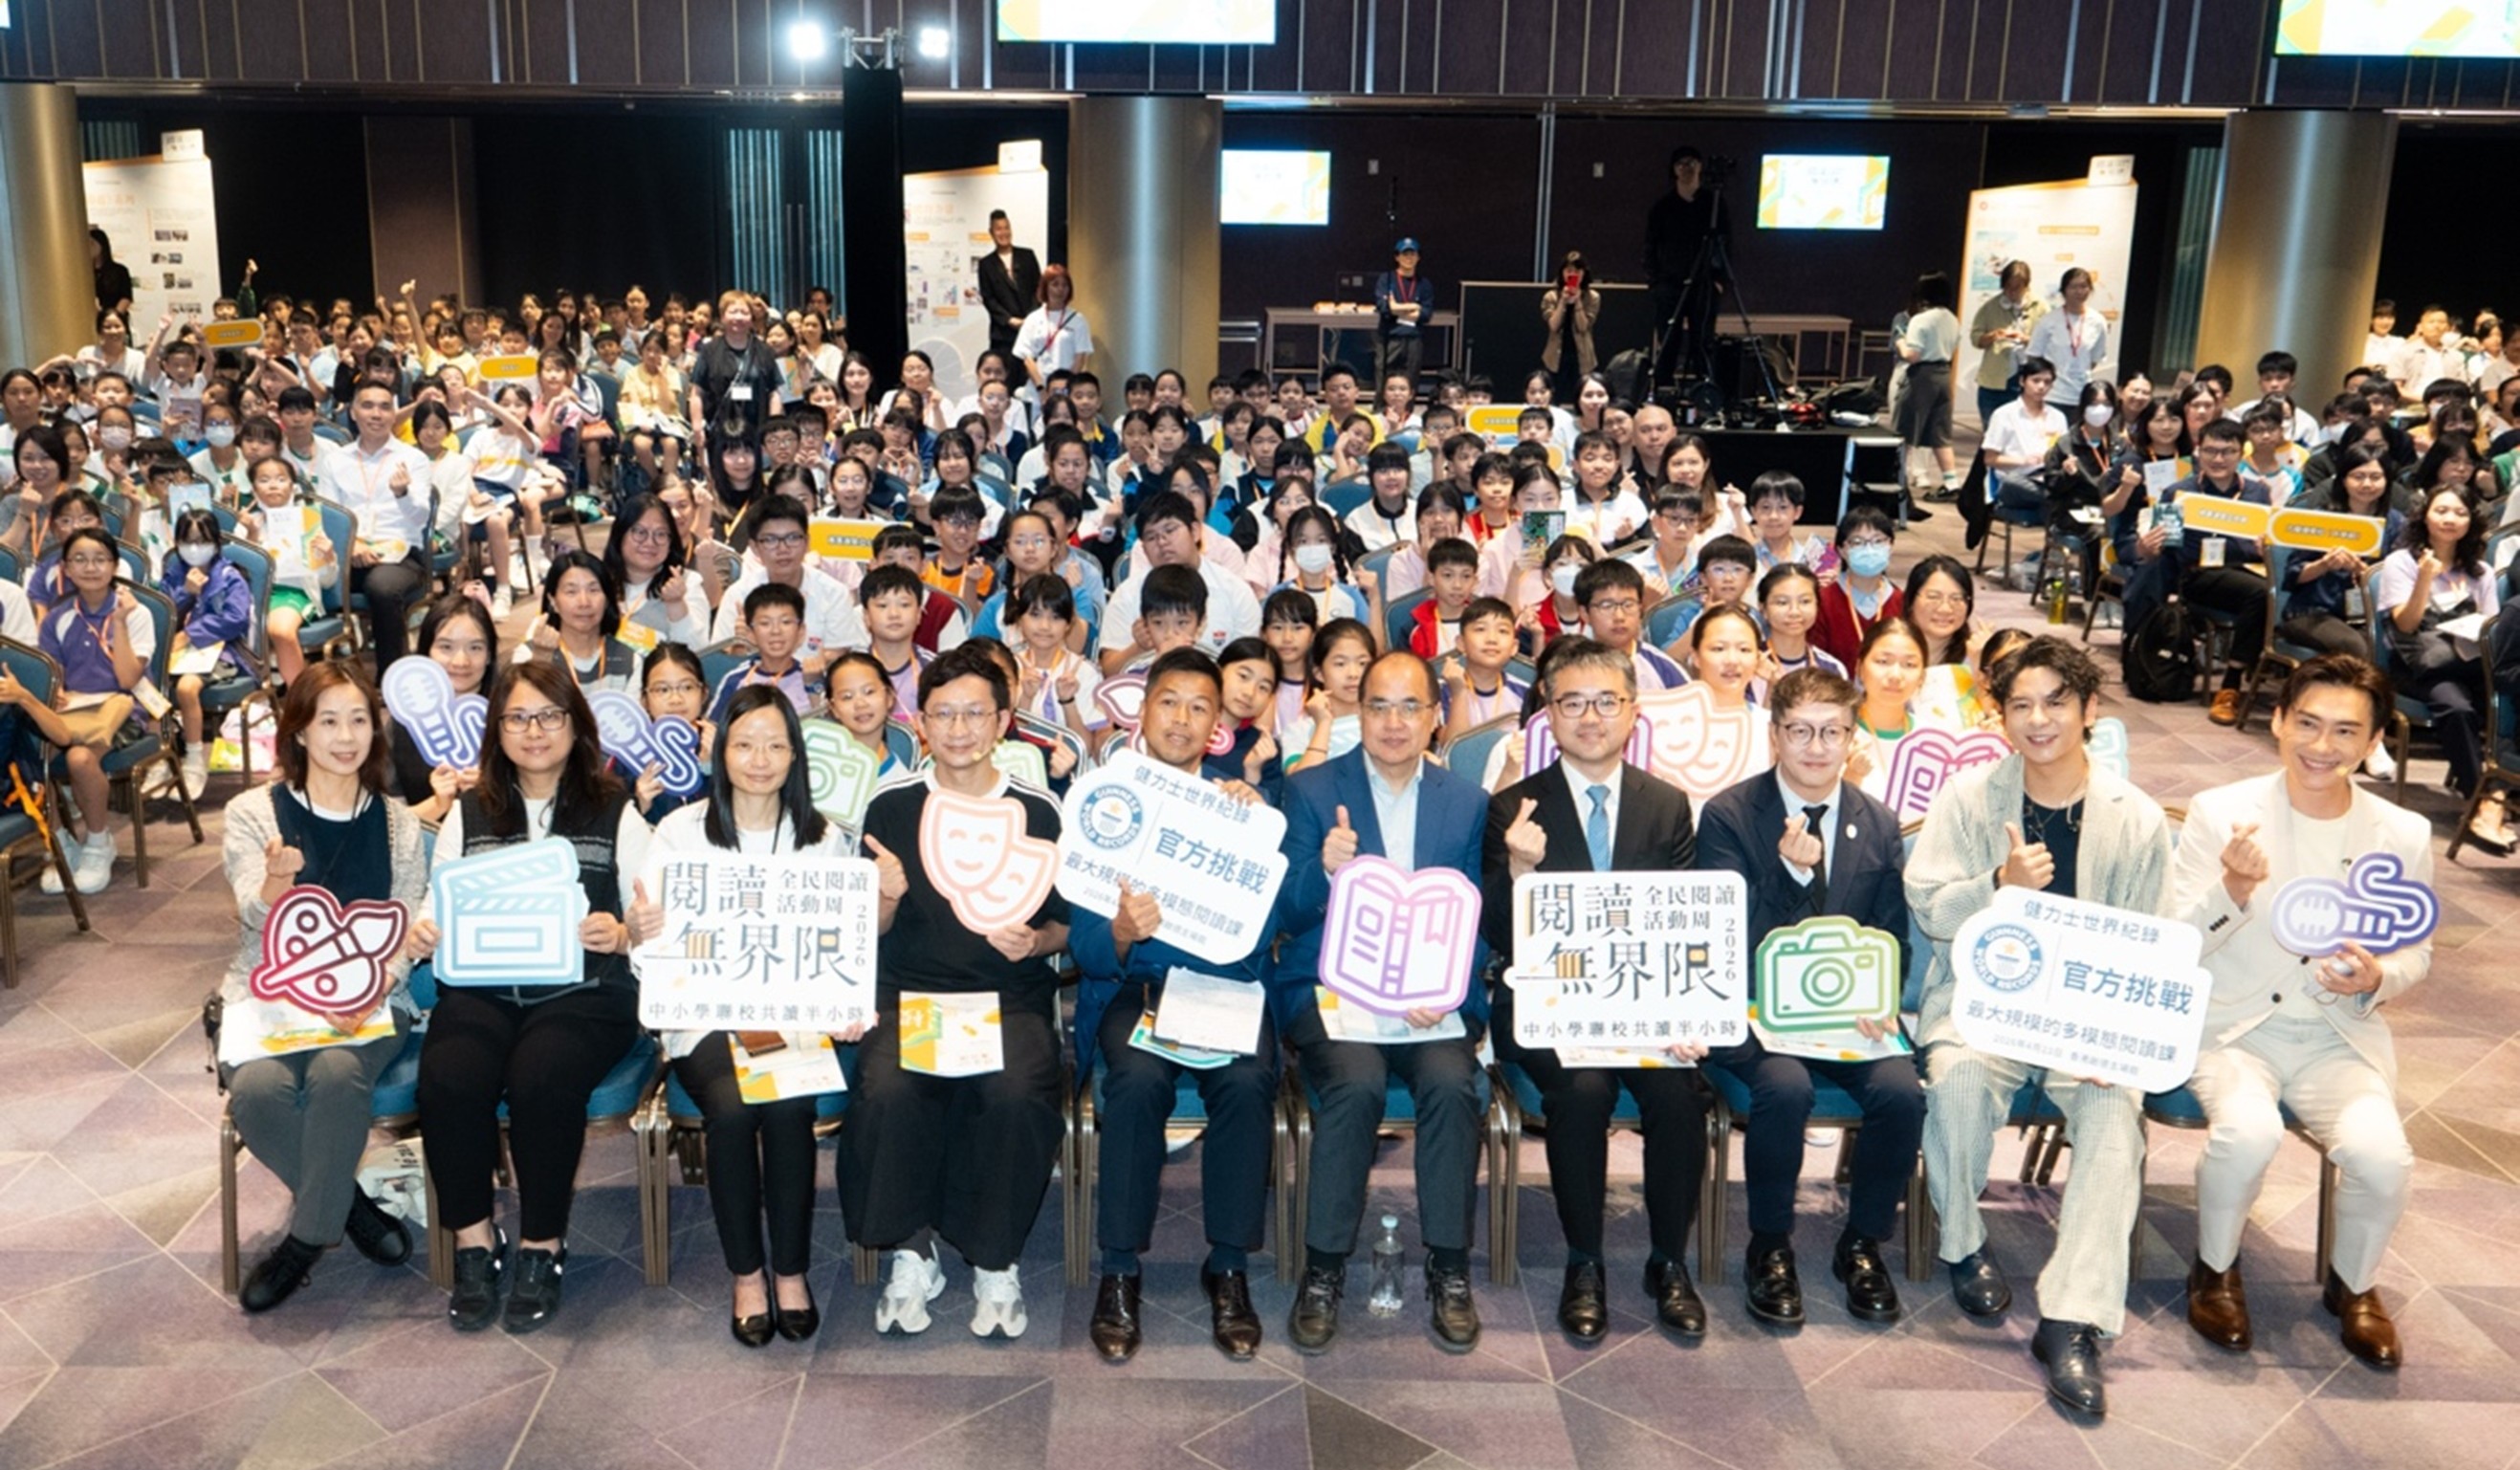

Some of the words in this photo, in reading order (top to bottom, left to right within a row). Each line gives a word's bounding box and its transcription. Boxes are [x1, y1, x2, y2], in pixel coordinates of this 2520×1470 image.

[779, 868, 869, 892] 全民閱讀
[1153, 826, 1270, 895] 官方挑戰
[660, 862, 767, 919] 閱讀
[777, 893, 844, 914] 活動周
[1527, 883, 1633, 937] 閱讀
[1644, 885, 1737, 907] 全民閱讀
[856, 904, 867, 967] 2026
[1643, 911, 1711, 931] 活動周
[643, 921, 860, 987] 無界限
[1515, 941, 1731, 1002] 無界限
[1724, 918, 1737, 981] 2026
[647, 1001, 865, 1022] 中小學聯校共讀半小時
[2063, 959, 2195, 1015] 官方挑戰
[1523, 1020, 1738, 1039] 中小學聯校共讀半小時
